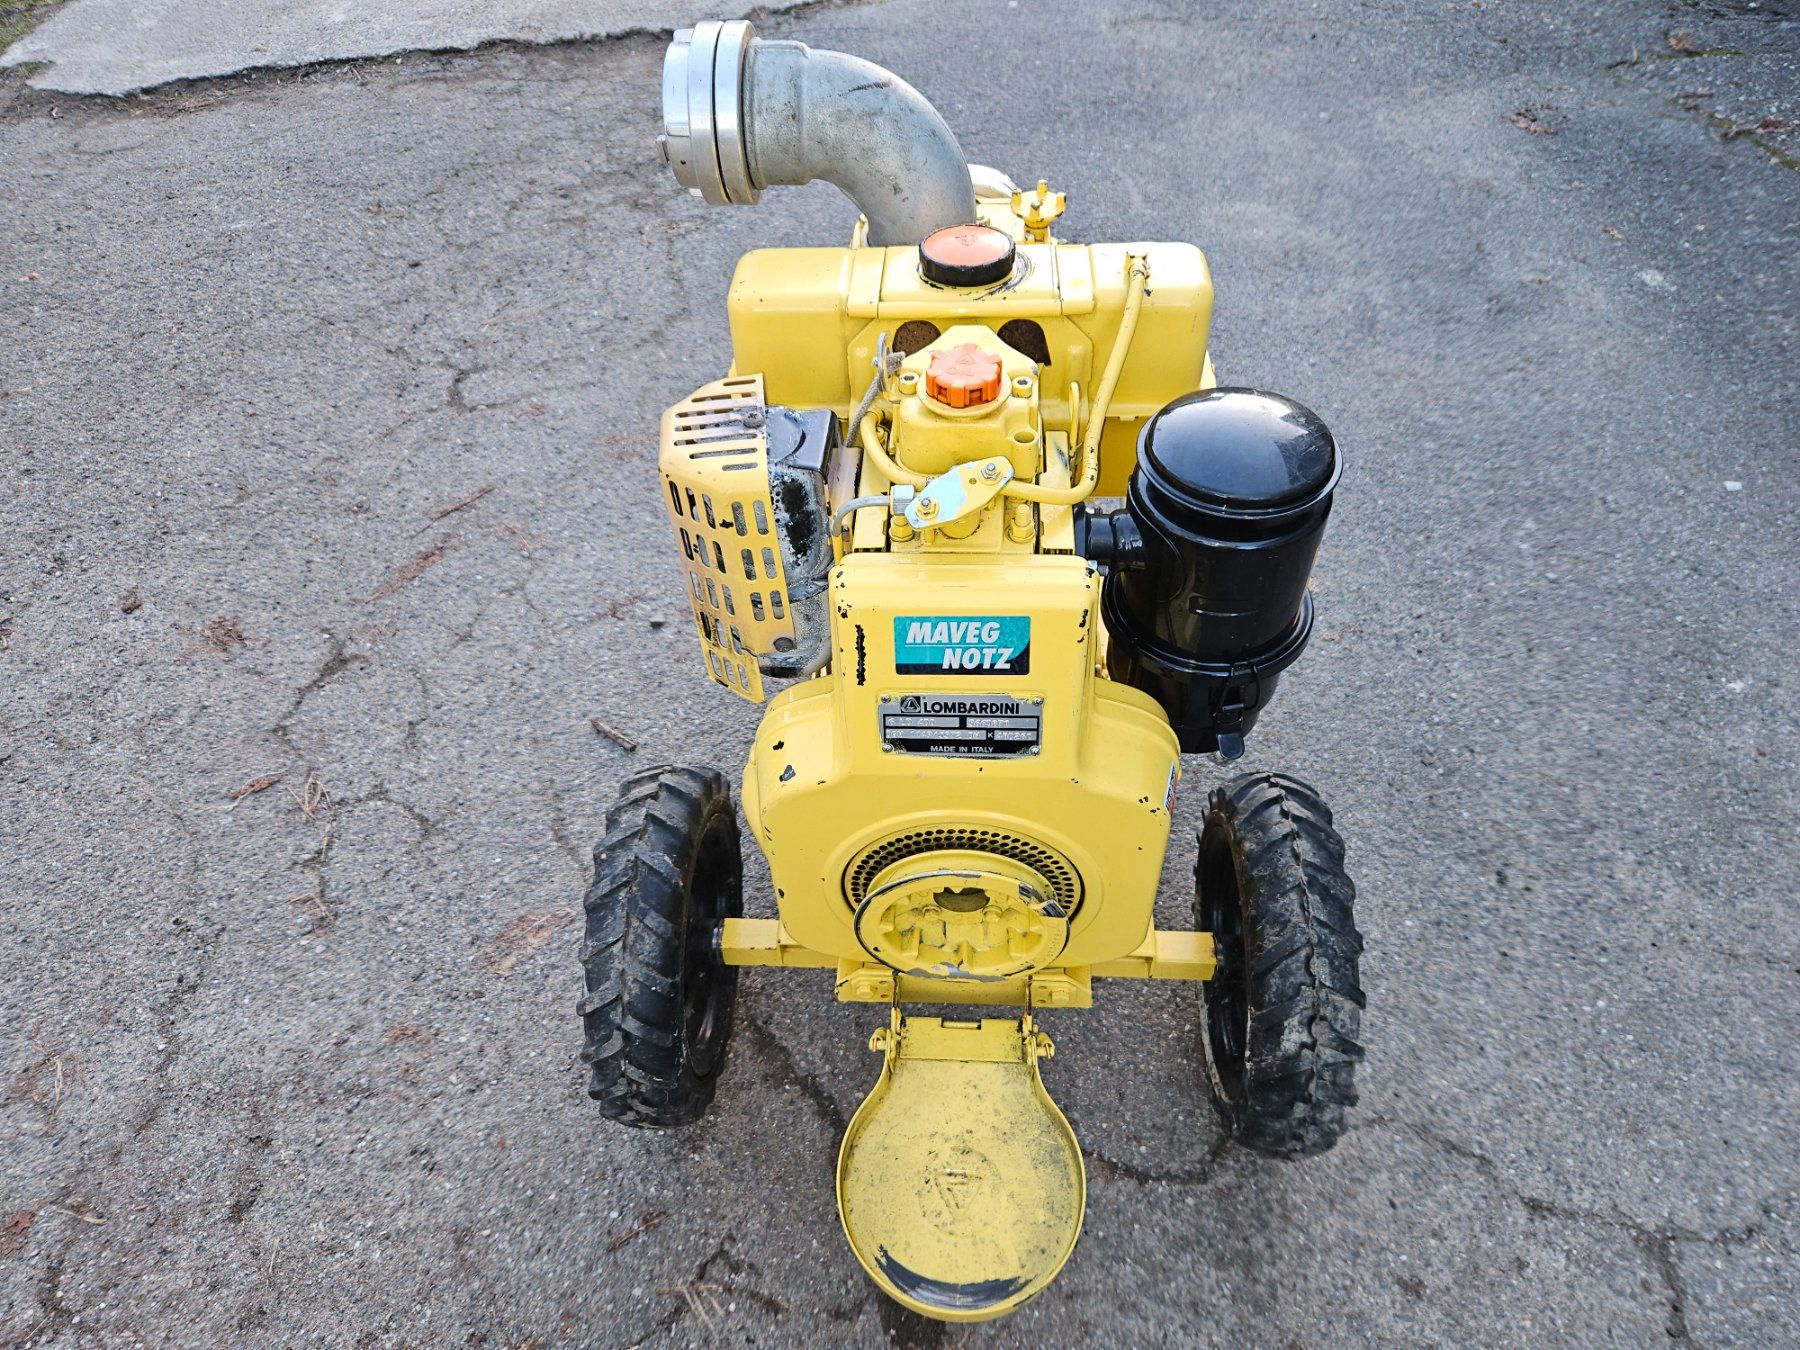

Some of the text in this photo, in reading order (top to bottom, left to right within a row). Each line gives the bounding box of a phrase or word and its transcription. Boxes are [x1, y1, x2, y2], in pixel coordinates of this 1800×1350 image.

[905, 621, 1000, 644] MAVEG
[942, 647, 1014, 669] NOTZ
[924, 702, 1020, 714] LOMBARDINI
[930, 745, 994, 753] MADE IN ITALY
